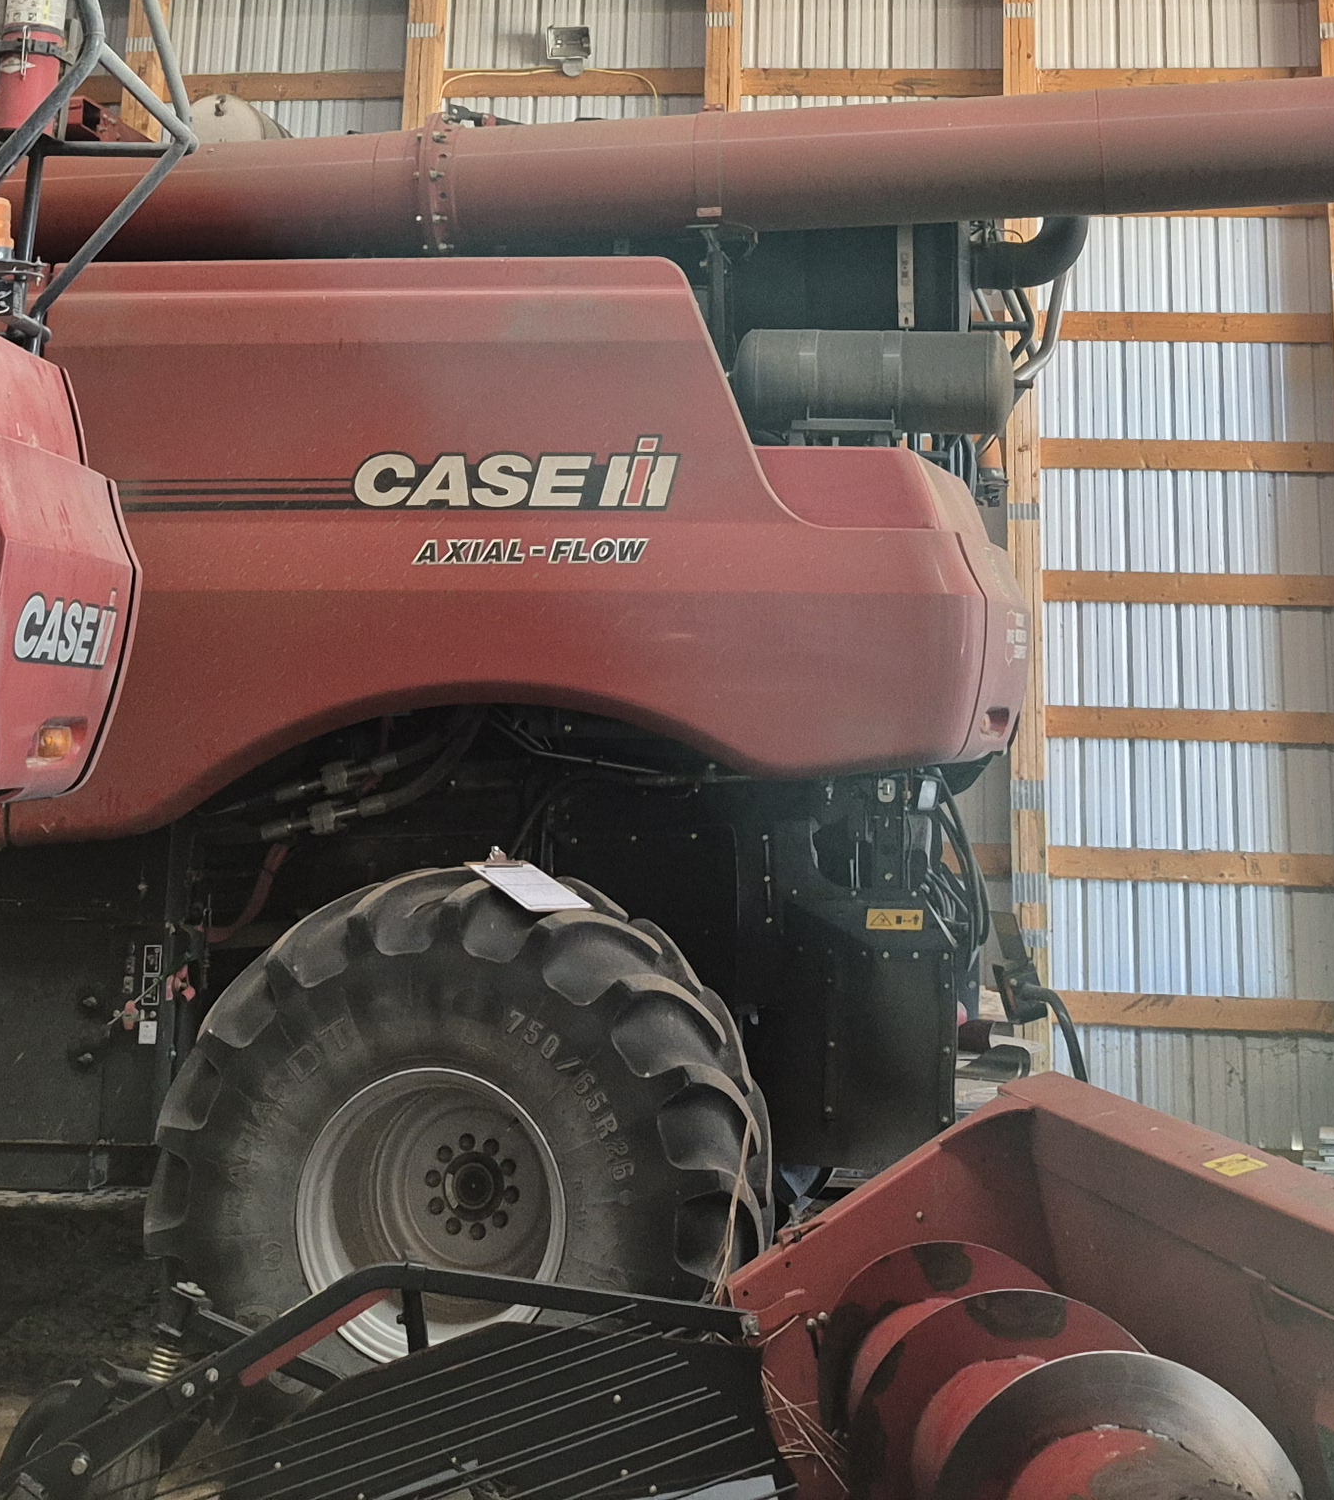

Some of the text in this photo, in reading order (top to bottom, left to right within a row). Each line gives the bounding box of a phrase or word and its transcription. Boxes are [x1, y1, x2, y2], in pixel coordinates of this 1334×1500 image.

[353, 453, 593, 508] CASE
[412, 537, 650, 565] AXIAL-FLOW
[14, 594, 100, 664] CASE
[506, 1009, 635, 1181] 750/65R26
